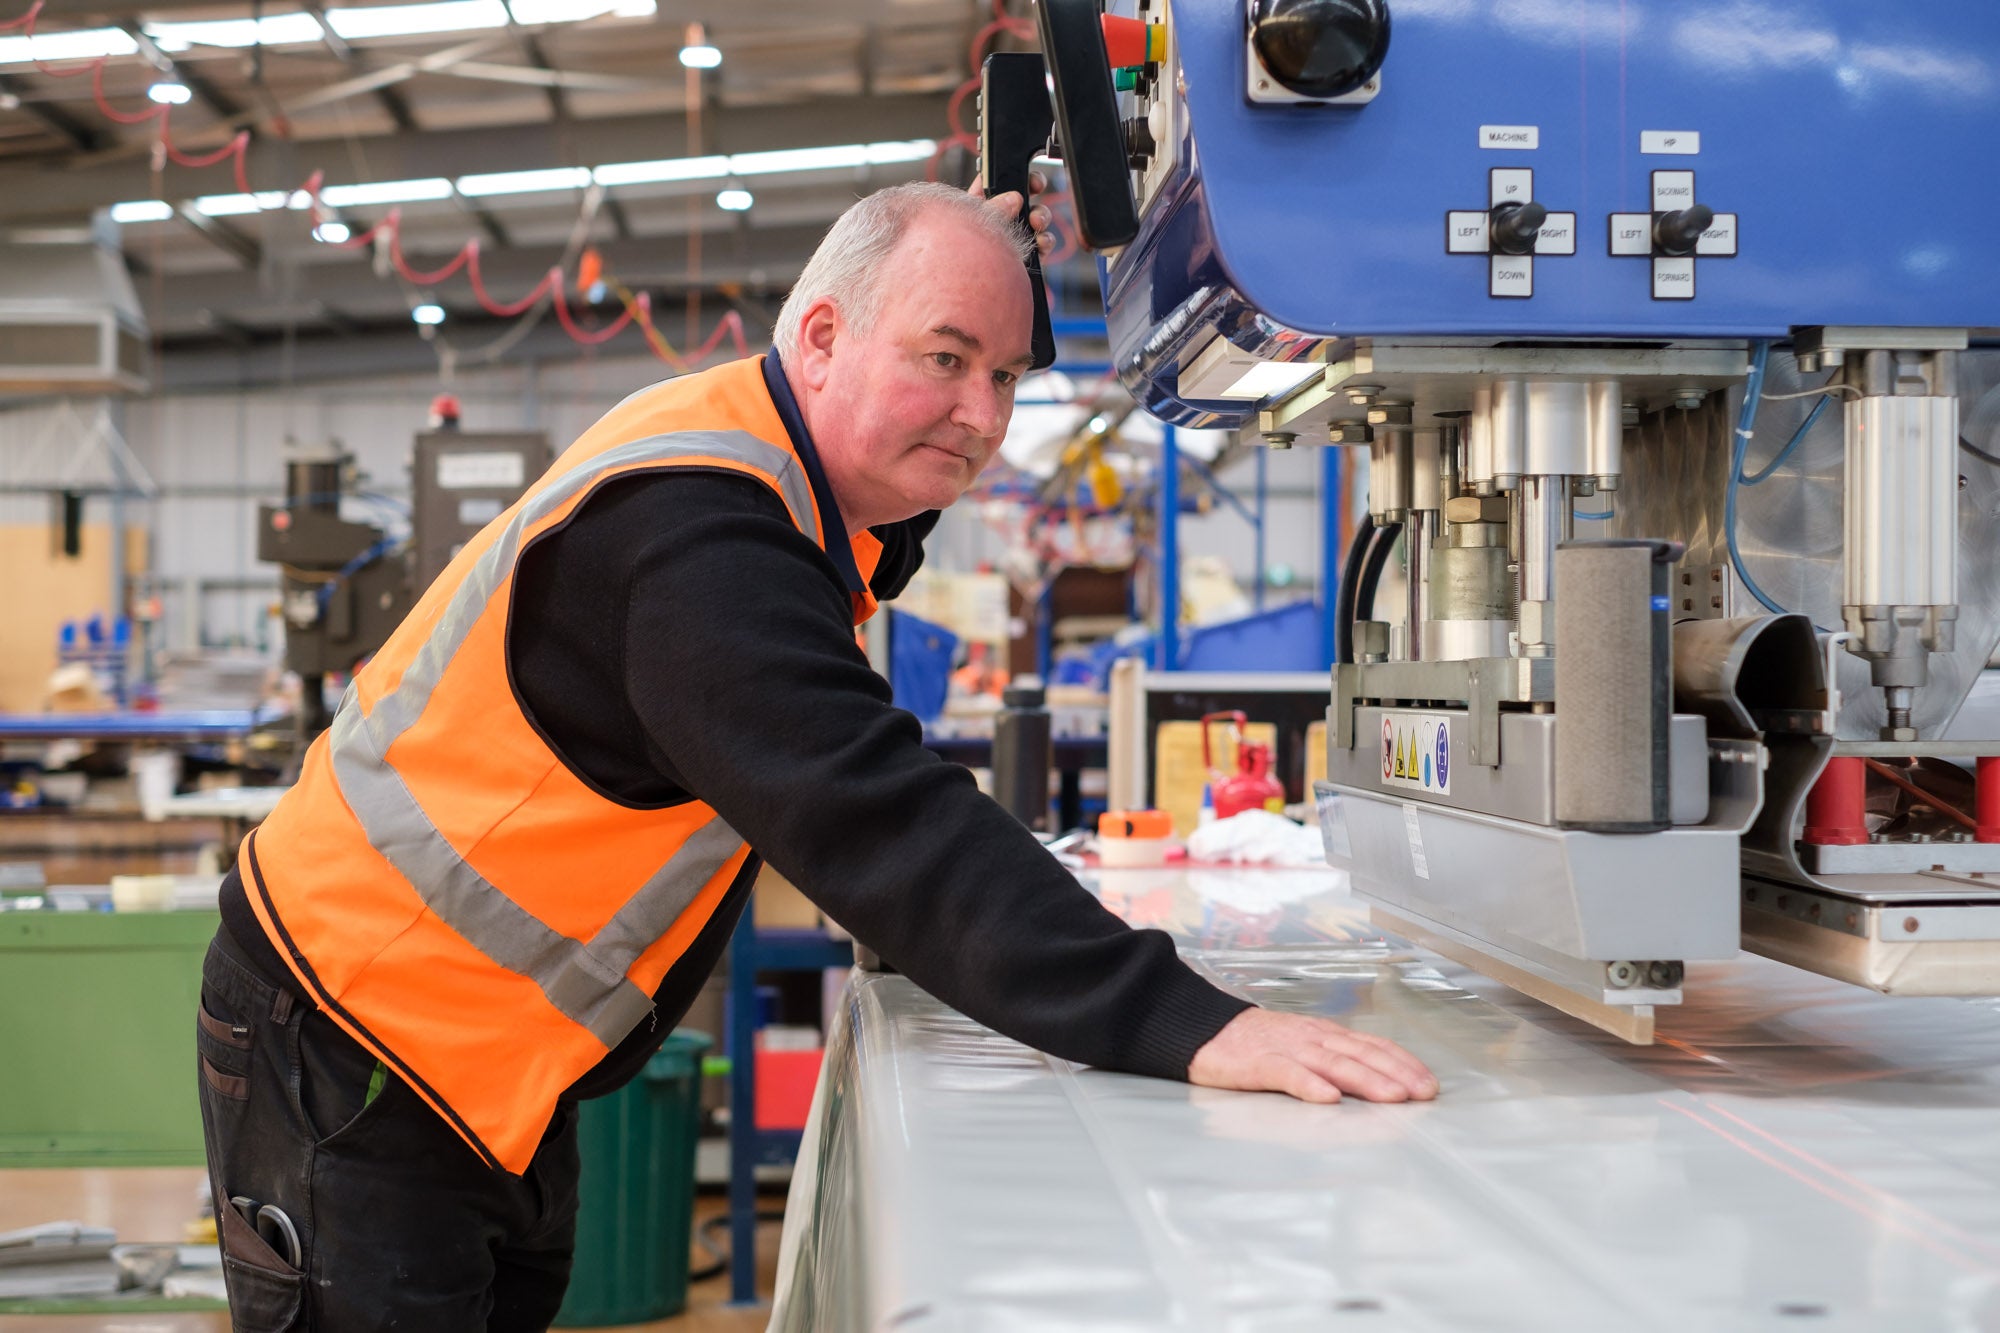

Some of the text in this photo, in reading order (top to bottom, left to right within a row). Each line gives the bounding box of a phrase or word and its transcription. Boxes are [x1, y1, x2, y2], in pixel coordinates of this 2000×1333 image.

[1489, 132, 1529, 143] MACHINE
[1663, 138, 1677, 148] HP
[1505, 185, 1518, 194] UP
[1457, 227, 1480, 237] LEFT
[1540, 228, 1568, 239] RIGHT
[1620, 229, 1642, 239] LEFT
[1702, 229, 1729, 240] RIGHT
[1498, 270, 1526, 280] DOWN
